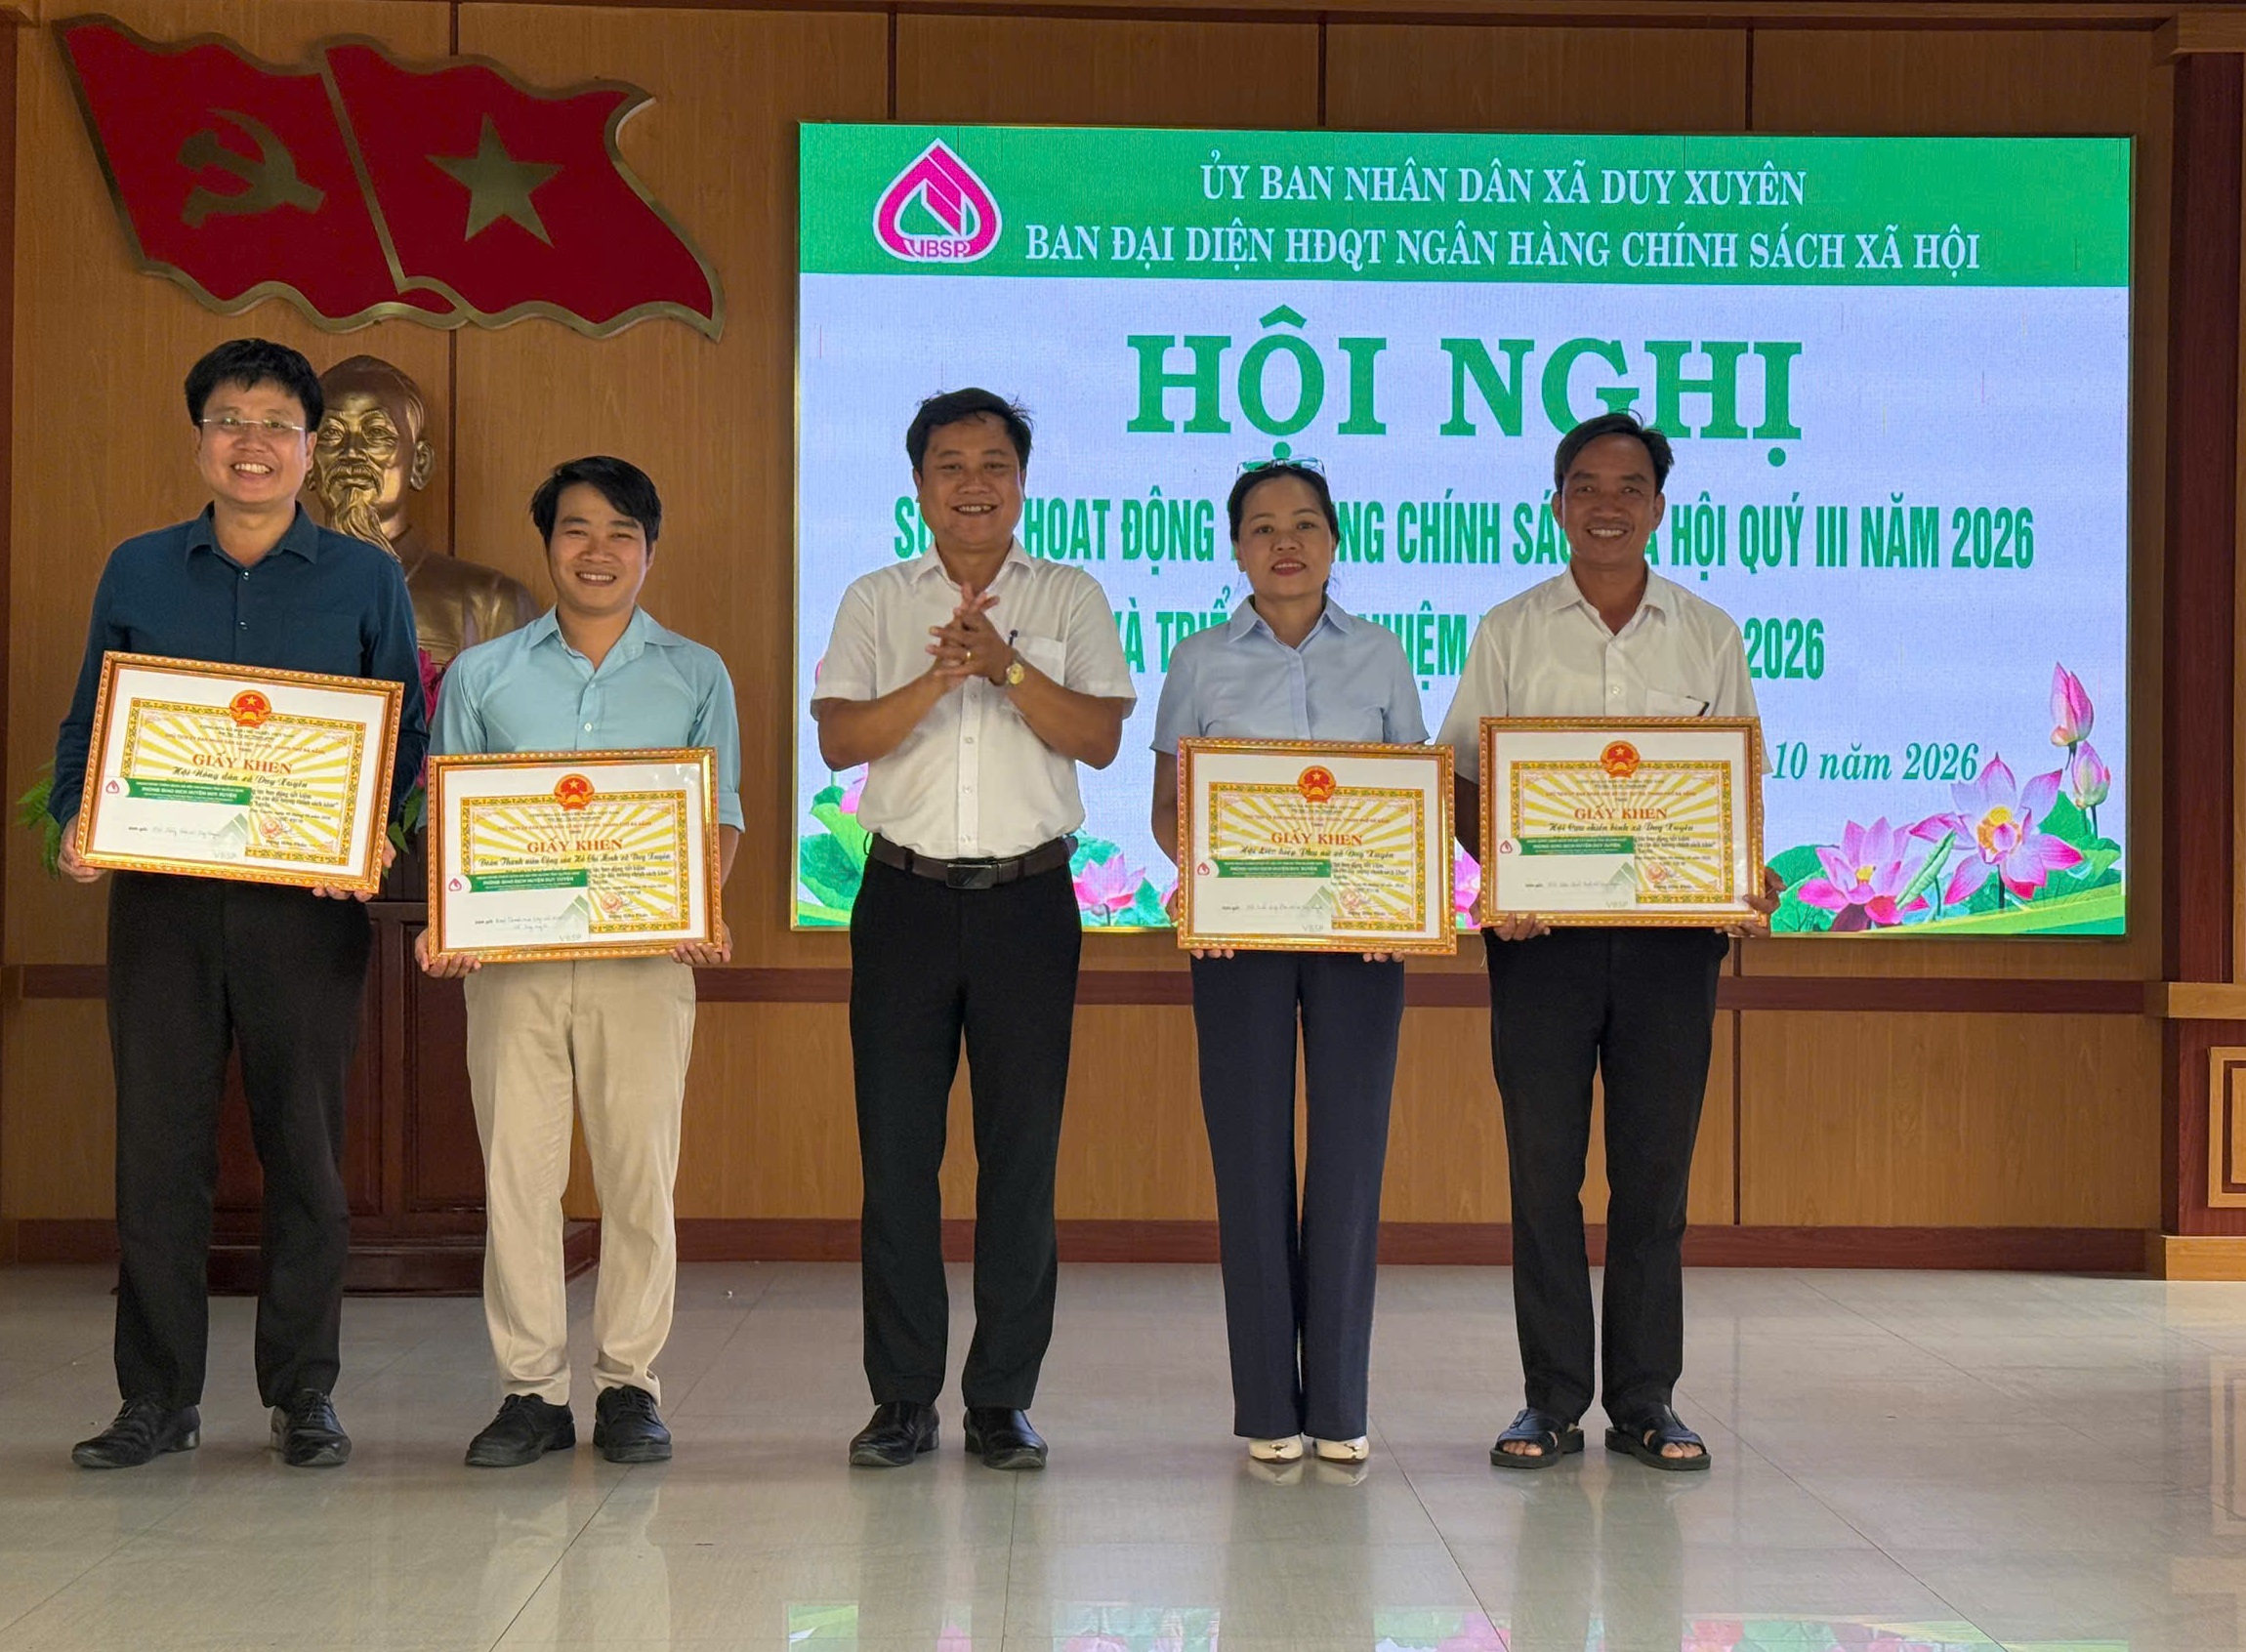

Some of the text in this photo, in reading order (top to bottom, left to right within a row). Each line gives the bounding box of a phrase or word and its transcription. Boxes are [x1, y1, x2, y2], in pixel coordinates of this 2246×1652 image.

[1200, 148, 1808, 206] ỦY BAN NHÂN DÂN XÃ DUY XUYÊN
[1024, 217, 1981, 279] BAN ĐẠI DIỆN HĐQT NGÂN HÀNG CHÍNH SÁCH XÃ HỘI
[1126, 304, 1803, 468] HỘI NGHỊ
[1025, 496, 1111, 572] HOẠT
[1120, 484, 1216, 576] ĐỘNG
[1337, 500, 1385, 564] NG
[1396, 488, 1501, 564] CHÍNH
[1513, 489, 1572, 565] SÁ
[1671, 490, 1726, 582] HỘI
[1738, 490, 1805, 575] QUÝ
[1815, 505, 1849, 567] III
[1860, 490, 1940, 568] NĂM
[1951, 506, 2035, 569] 2026
[1743, 617, 1826, 681] 2026
[191, 751, 293, 775] GIẤY KHEN
[1770, 740, 1980, 781] 10 năm 2026
[1573, 802, 1668, 820] GIẤY KHEN
[527, 836, 624, 854] GIẤY KHEN
[1270, 827, 1363, 847] GIẤY KHEN
